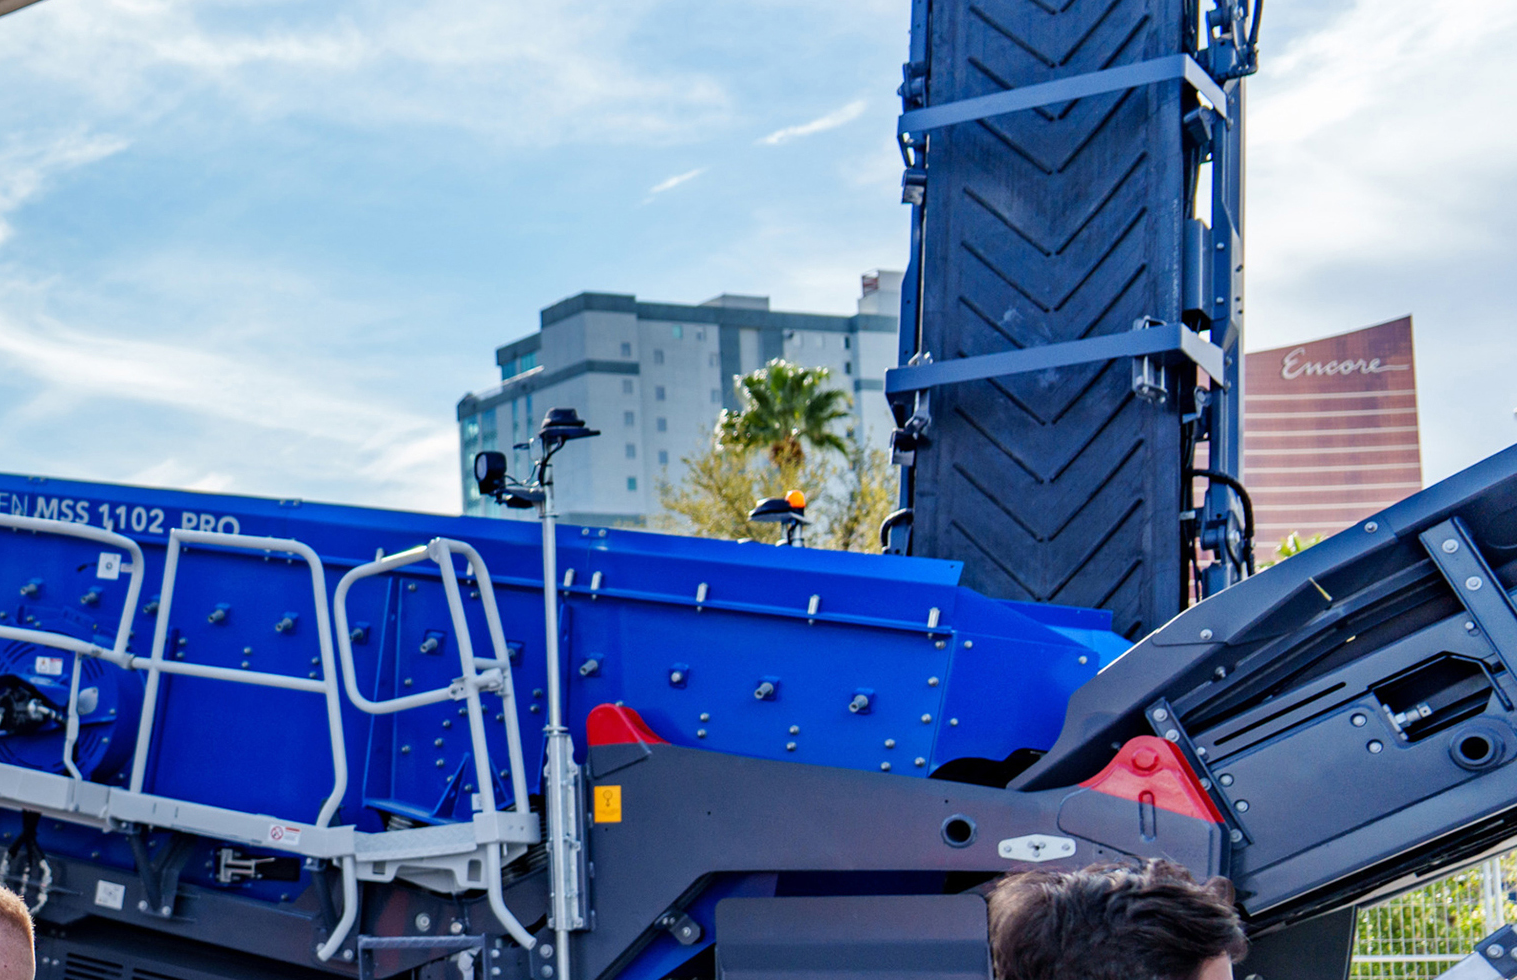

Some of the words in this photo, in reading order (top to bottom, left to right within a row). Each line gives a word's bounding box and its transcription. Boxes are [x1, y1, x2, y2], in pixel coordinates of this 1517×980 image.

[1281, 347, 1410, 380] Encore
[34, 496, 90, 524] MSS
[98, 503, 165, 534] 1102
[181, 511, 240, 536] PRO
